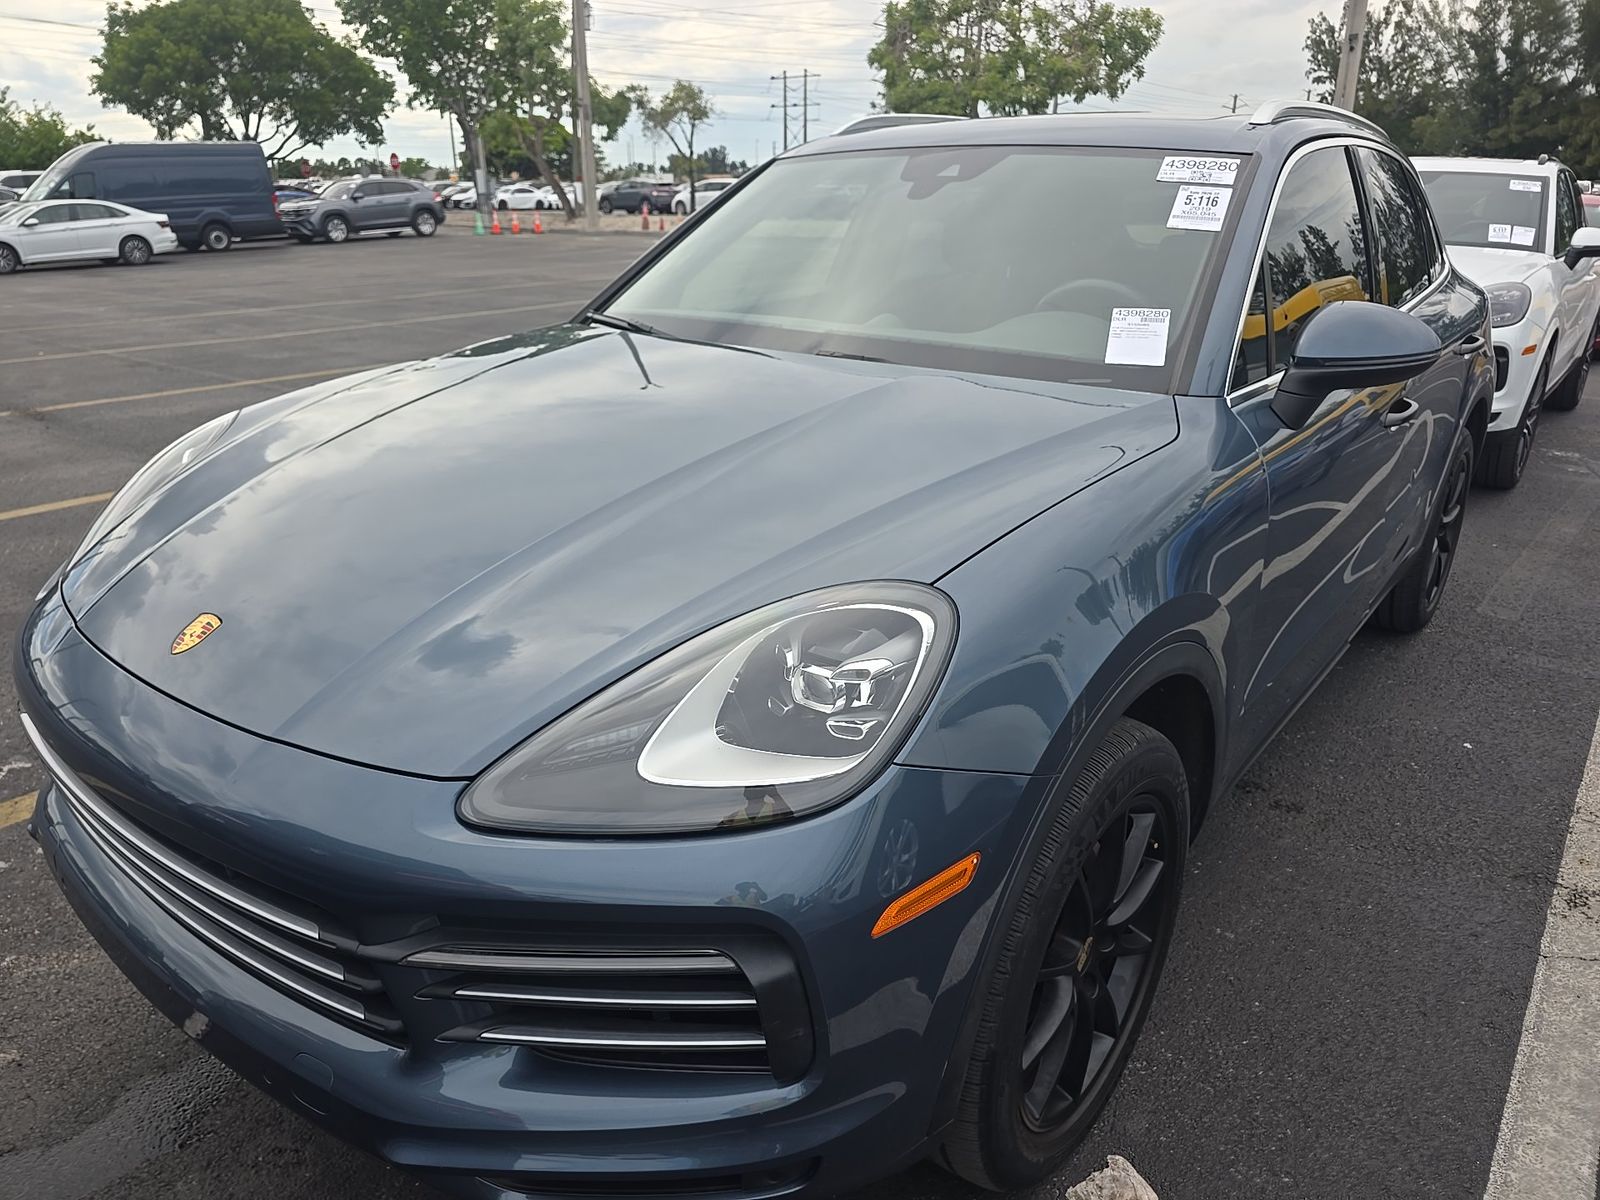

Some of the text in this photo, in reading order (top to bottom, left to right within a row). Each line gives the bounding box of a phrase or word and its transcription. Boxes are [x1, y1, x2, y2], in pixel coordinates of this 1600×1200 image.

[1165, 159, 1239, 172] 4398280
[1184, 195, 1220, 207] 5:116
[1115, 309, 1169, 318] 4398280
